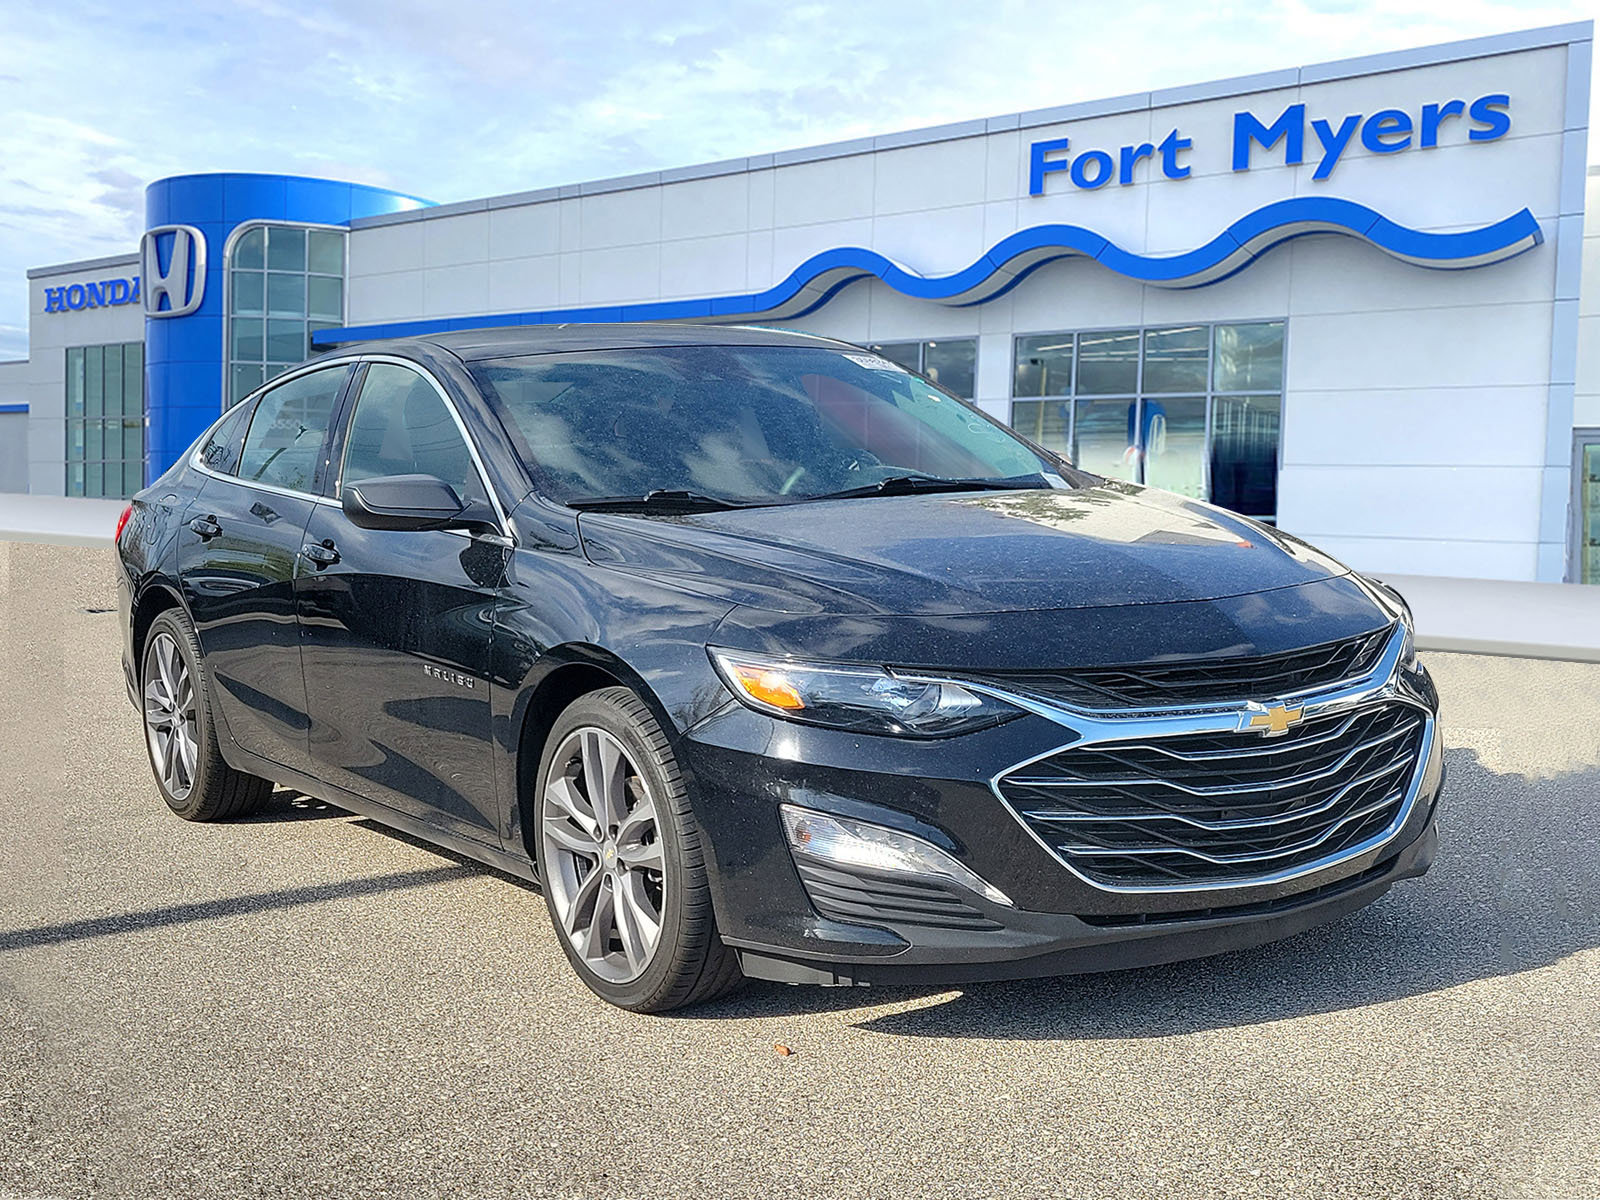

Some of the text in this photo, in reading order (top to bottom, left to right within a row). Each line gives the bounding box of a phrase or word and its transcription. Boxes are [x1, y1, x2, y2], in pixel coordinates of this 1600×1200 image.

[1029, 94, 1511, 196] Fort Myers
[423, 664, 474, 689] MALIBU
